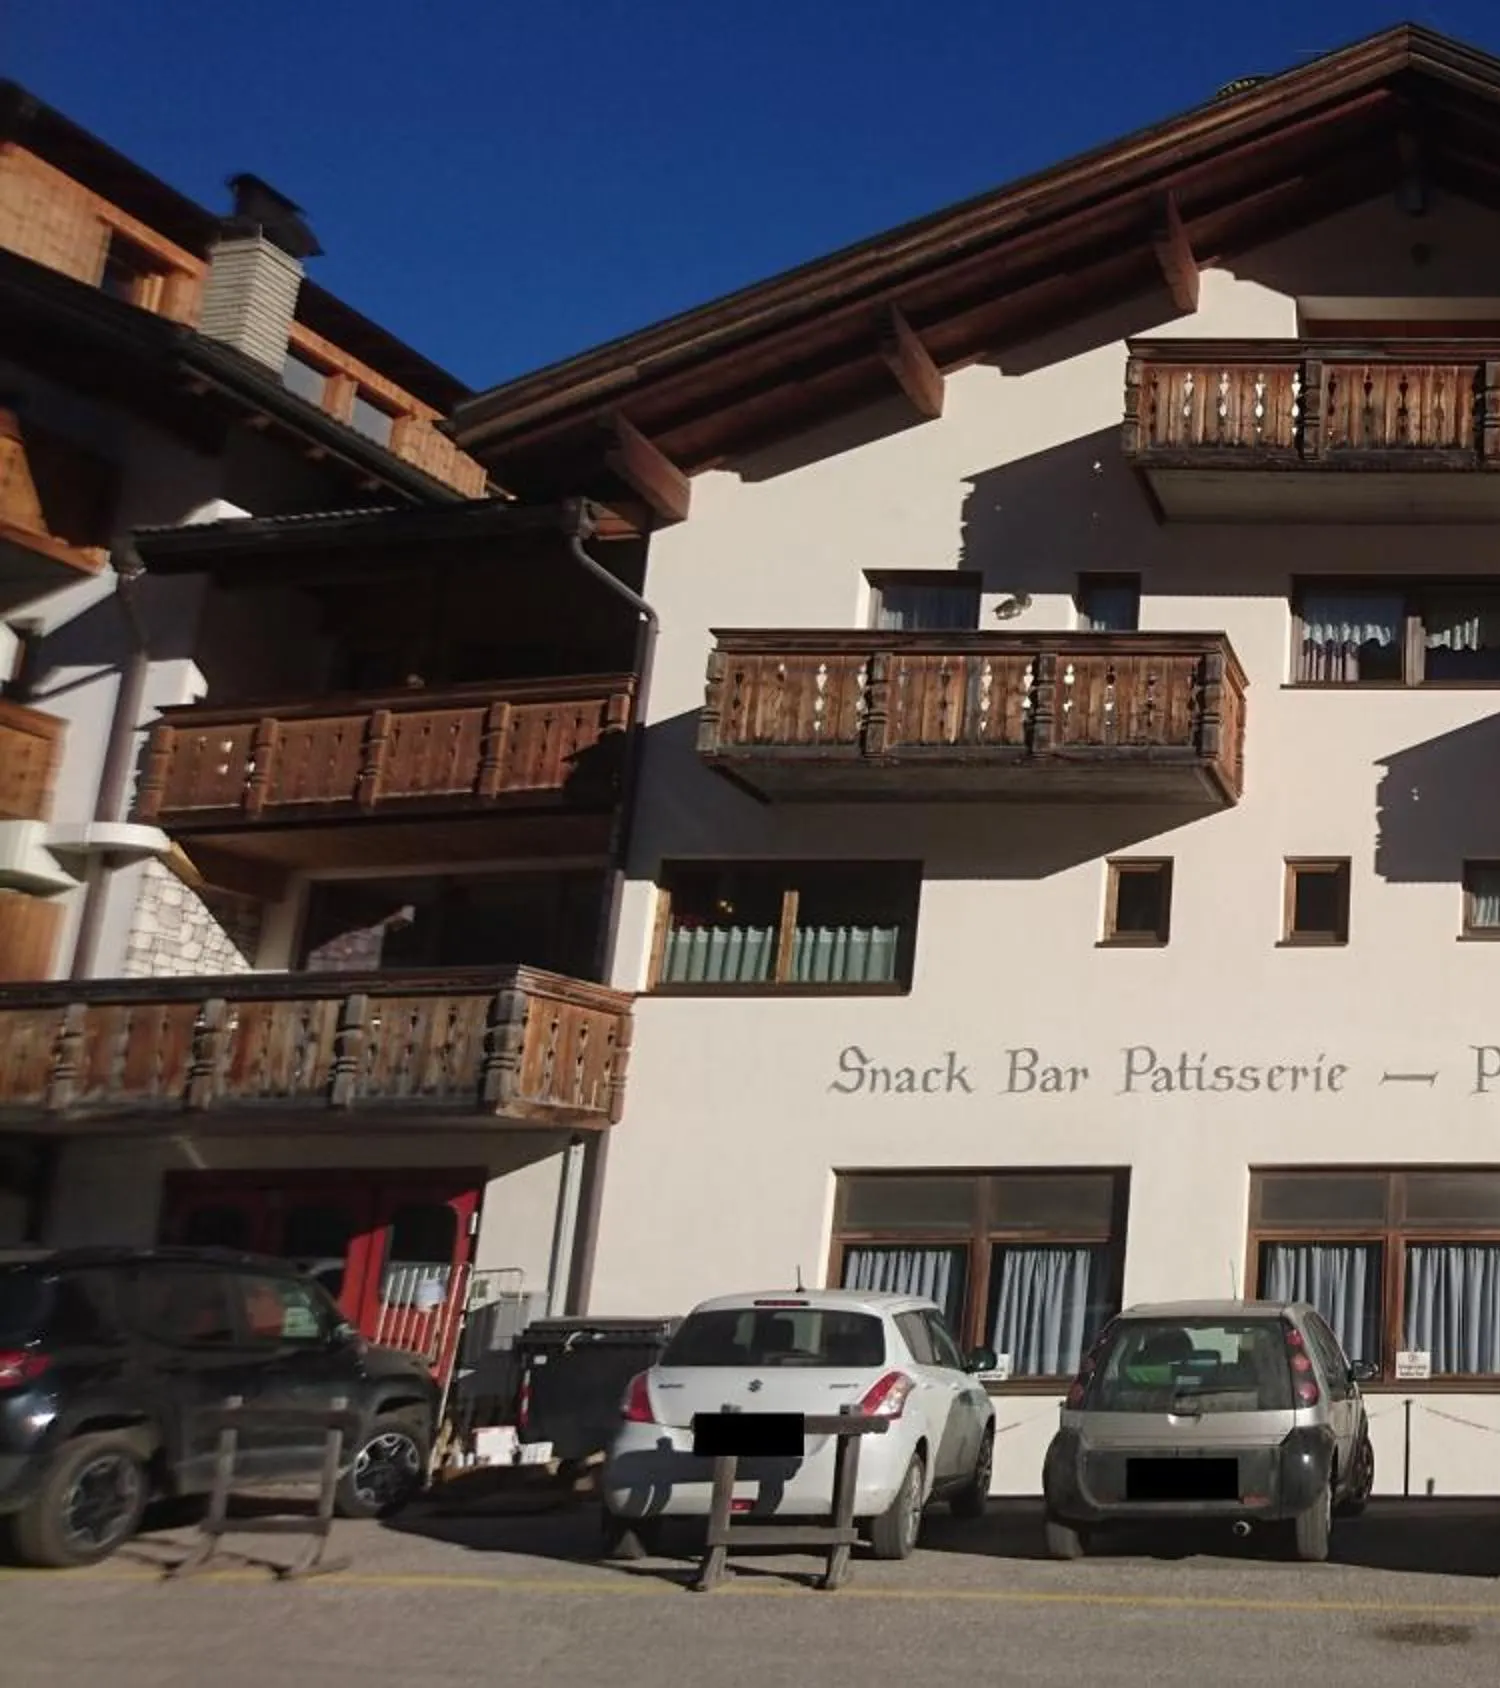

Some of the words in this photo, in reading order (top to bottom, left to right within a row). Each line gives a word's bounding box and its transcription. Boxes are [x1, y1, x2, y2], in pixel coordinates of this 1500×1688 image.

[828, 1044, 975, 1095] Snack
[999, 1046, 1089, 1095] Bar
[1115, 1045, 1349, 1096] Patisserie
